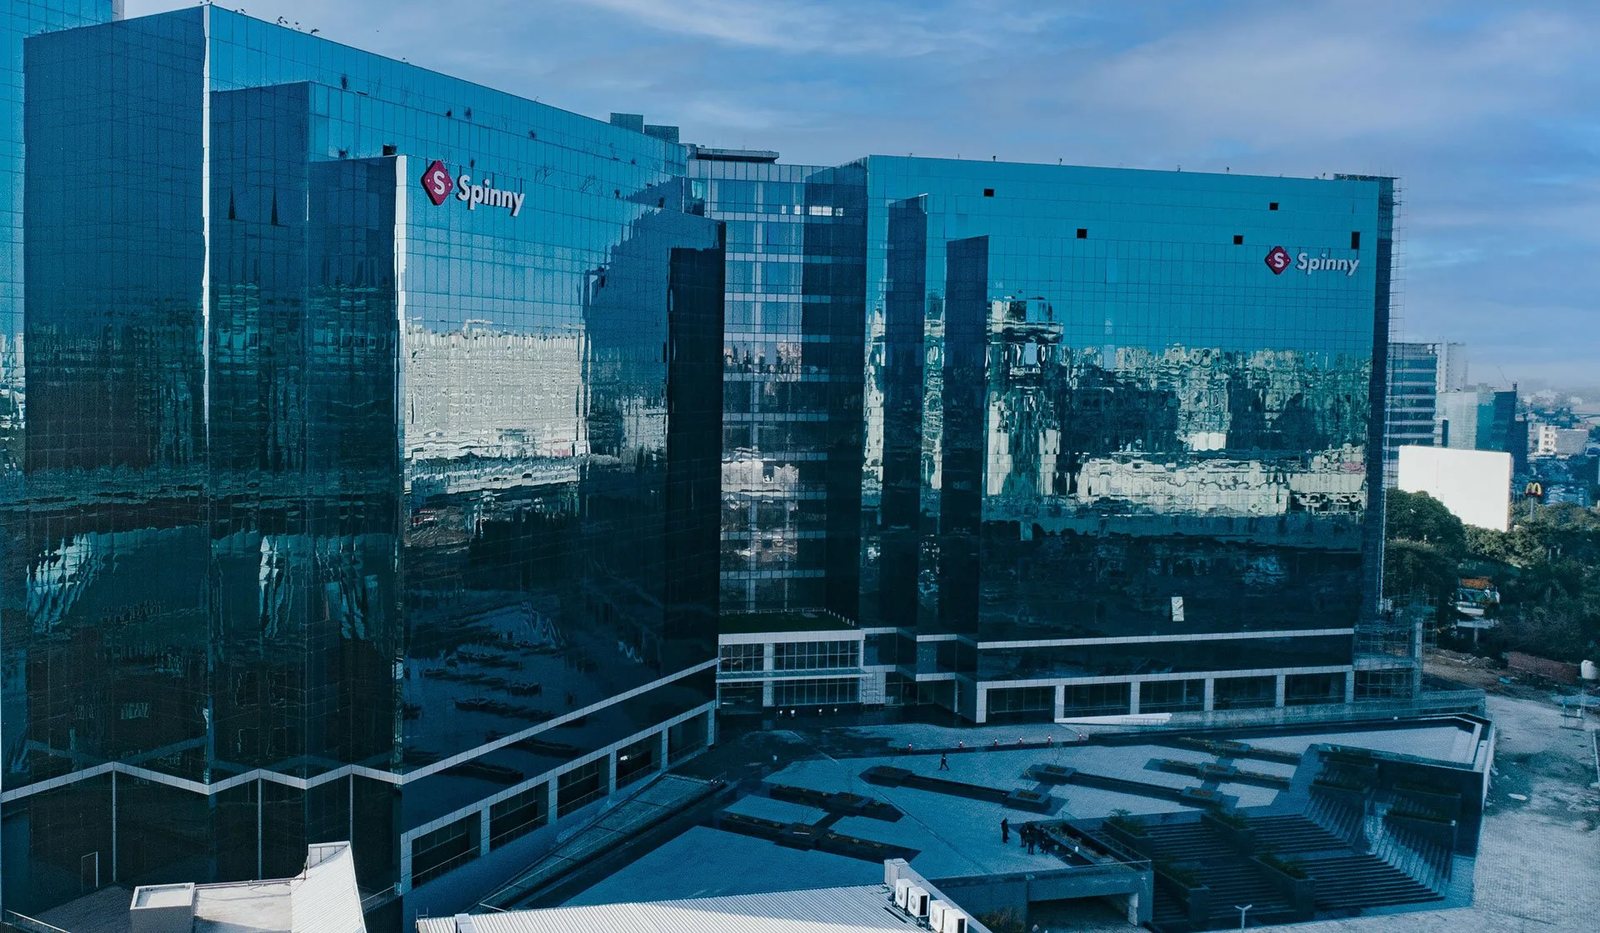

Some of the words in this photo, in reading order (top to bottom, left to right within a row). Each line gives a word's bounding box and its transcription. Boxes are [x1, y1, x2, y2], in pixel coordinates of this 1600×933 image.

[433, 170, 446, 195] S
[457, 174, 525, 217] Spinny
[1273, 252, 1285, 268] S
[1296, 252, 1360, 276] Spinny
